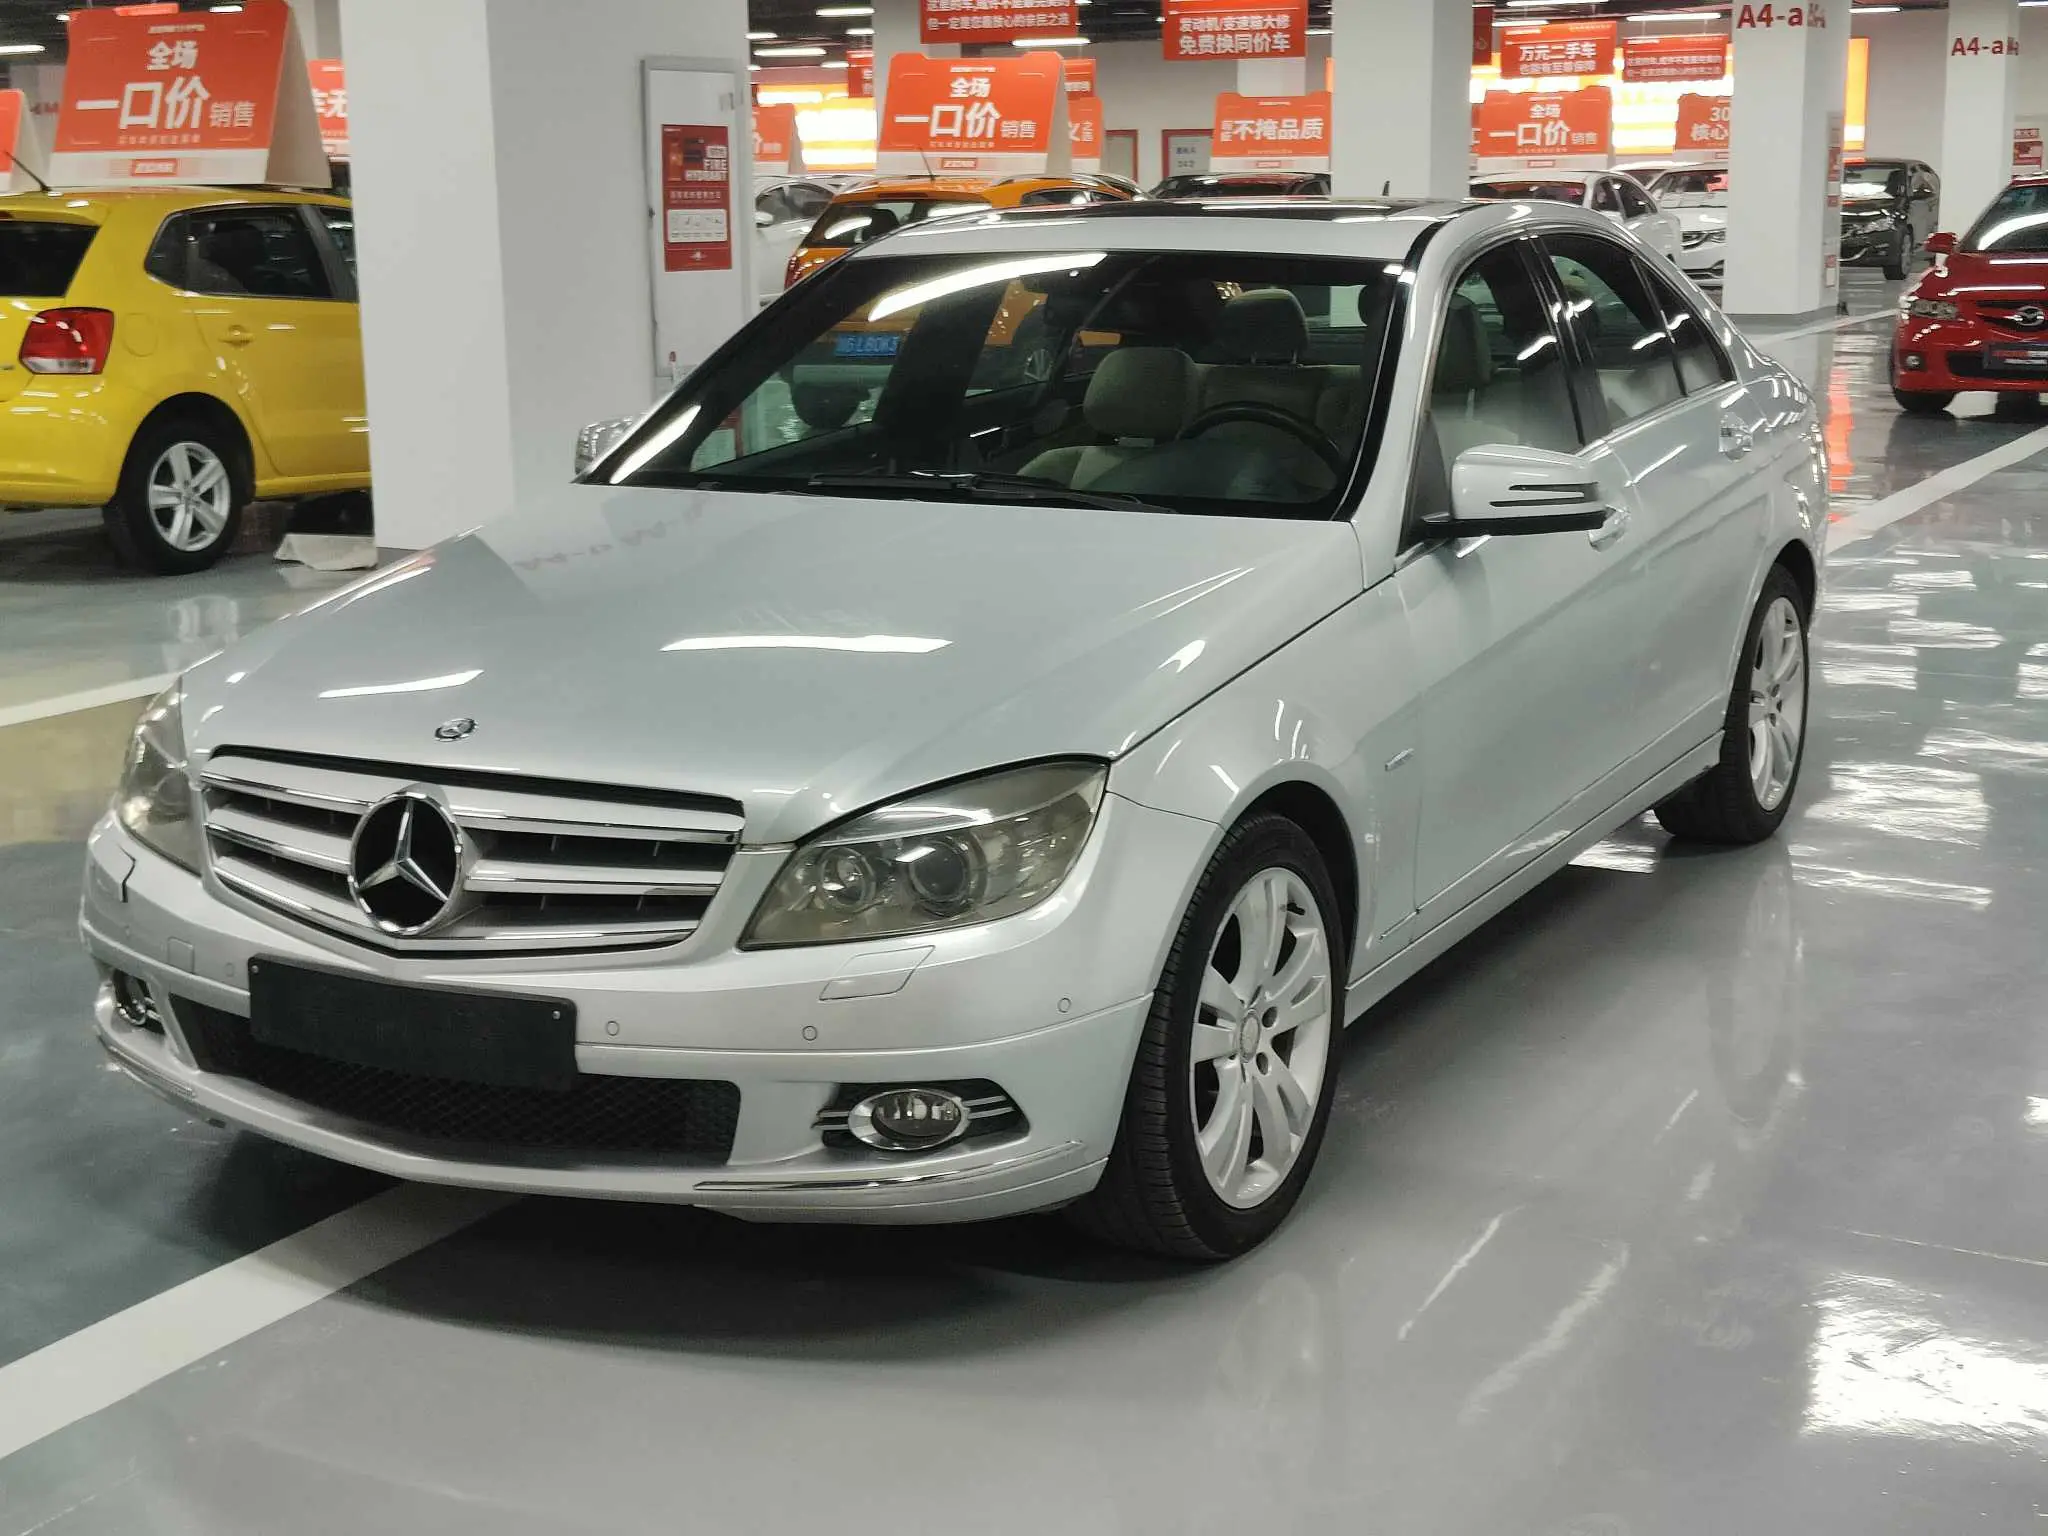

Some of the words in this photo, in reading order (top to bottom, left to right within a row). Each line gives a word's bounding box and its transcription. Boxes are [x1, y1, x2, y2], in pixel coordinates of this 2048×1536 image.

[1179, 32, 1291, 55] 免费换同价车
[1519, 41, 1597, 61] 万元二手车
[147, 40, 198, 71] 全场
[950, 77, 991, 98] 全场
[76, 75, 211, 130] 一口价
[209, 101, 256, 128] 销售
[1529, 103, 1562, 119] 全场
[895, 101, 1001, 139] 一口价
[1000, 120, 1037, 139] 销售
[1233, 117, 1324, 141] 不掩品质
[1489, 120, 1571, 147] 一口价
[1690, 123, 1729, 142] 核心
